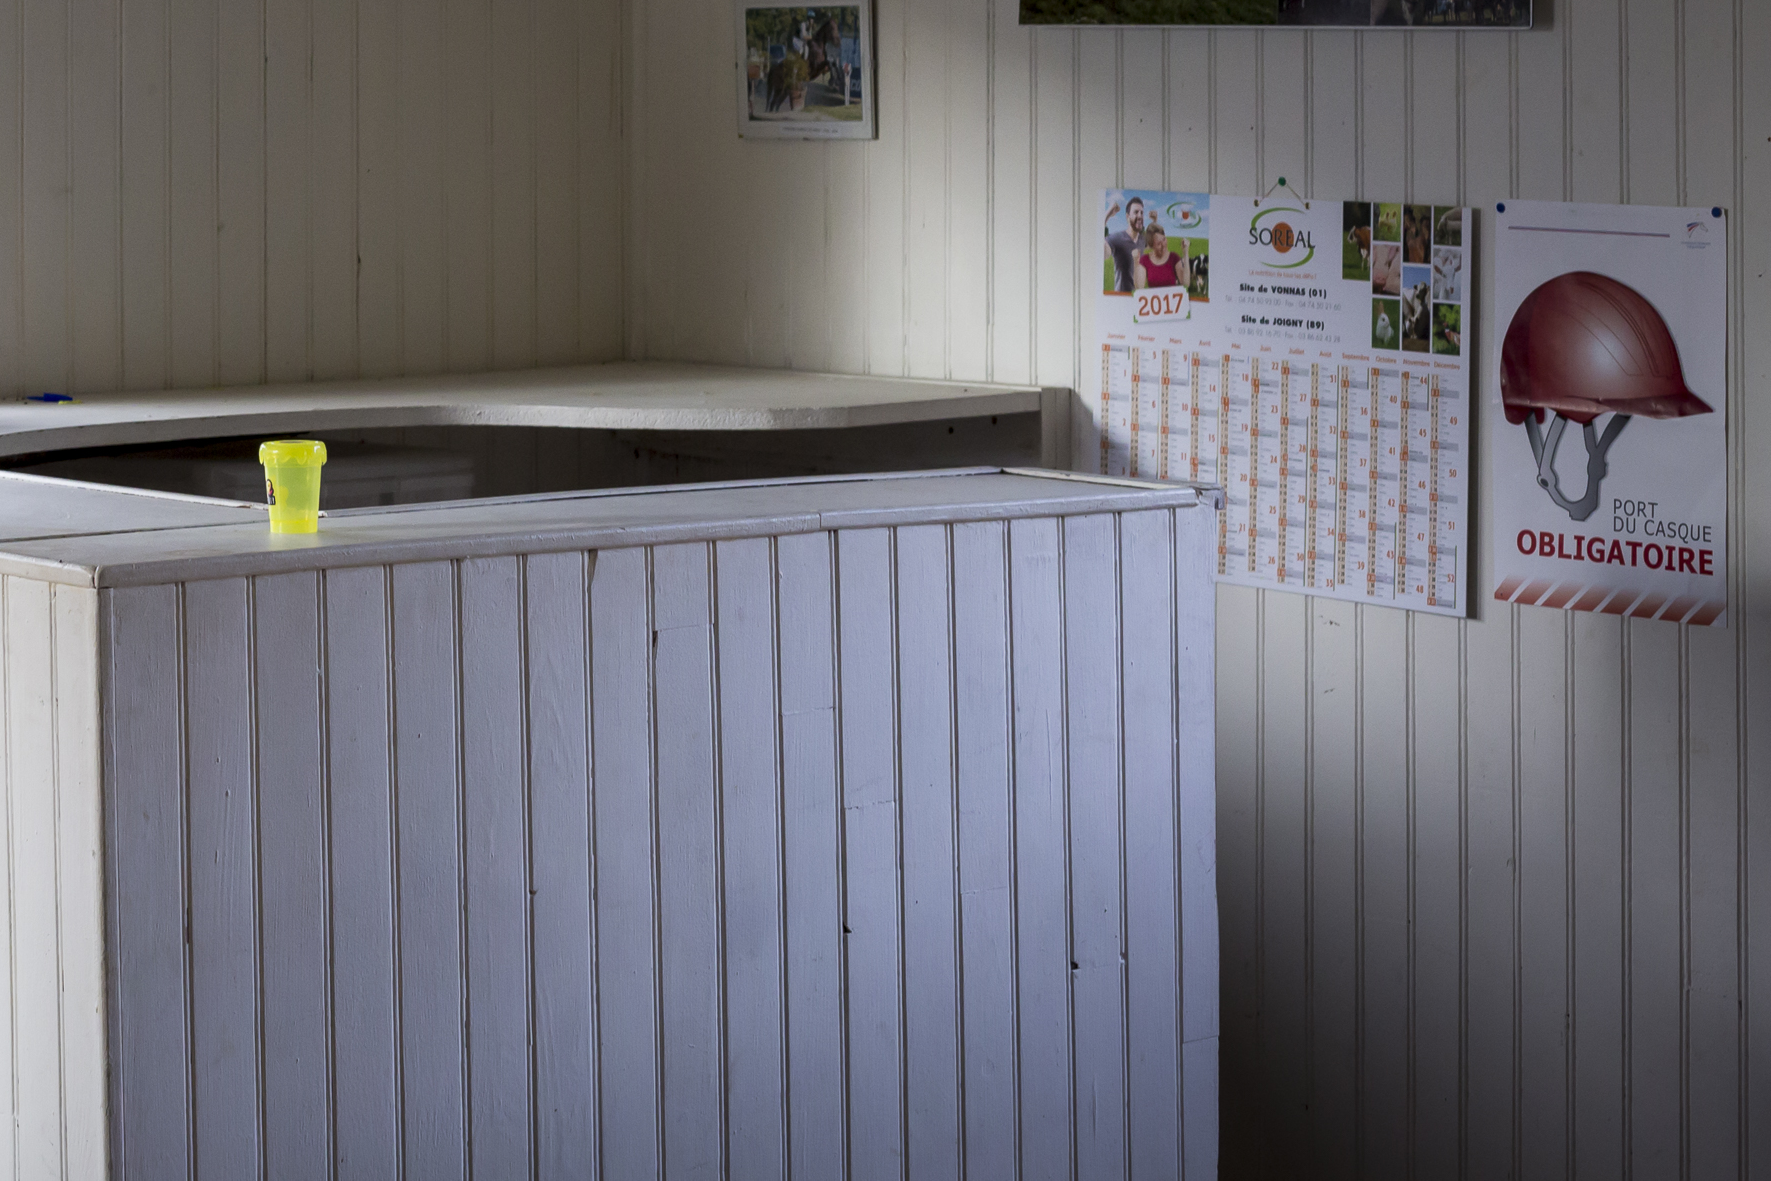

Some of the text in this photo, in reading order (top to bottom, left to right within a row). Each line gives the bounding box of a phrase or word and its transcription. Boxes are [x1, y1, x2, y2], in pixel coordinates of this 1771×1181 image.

[1248, 227, 1316, 249] SOREAL
[1240, 283, 1327, 299] Site de VONNAS (01)
[1138, 293, 1184, 317] 2017
[1241, 314, 1325, 331] Site de JOIGNY (89)
[1138, 334, 1156, 342] Février
[1288, 347, 1305, 355] Juillet
[1319, 350, 1332, 358] Août
[1342, 352, 1370, 361] Septembre
[1375, 356, 1397, 364] Octobre
[1403, 358, 1431, 367] Novembre
[1434, 361, 1461, 370] Décembre
[1613, 498, 1659, 519] PORT
[1613, 516, 1713, 545] DU CASQUE
[1516, 528, 1715, 577] OBLIGATOIRE
